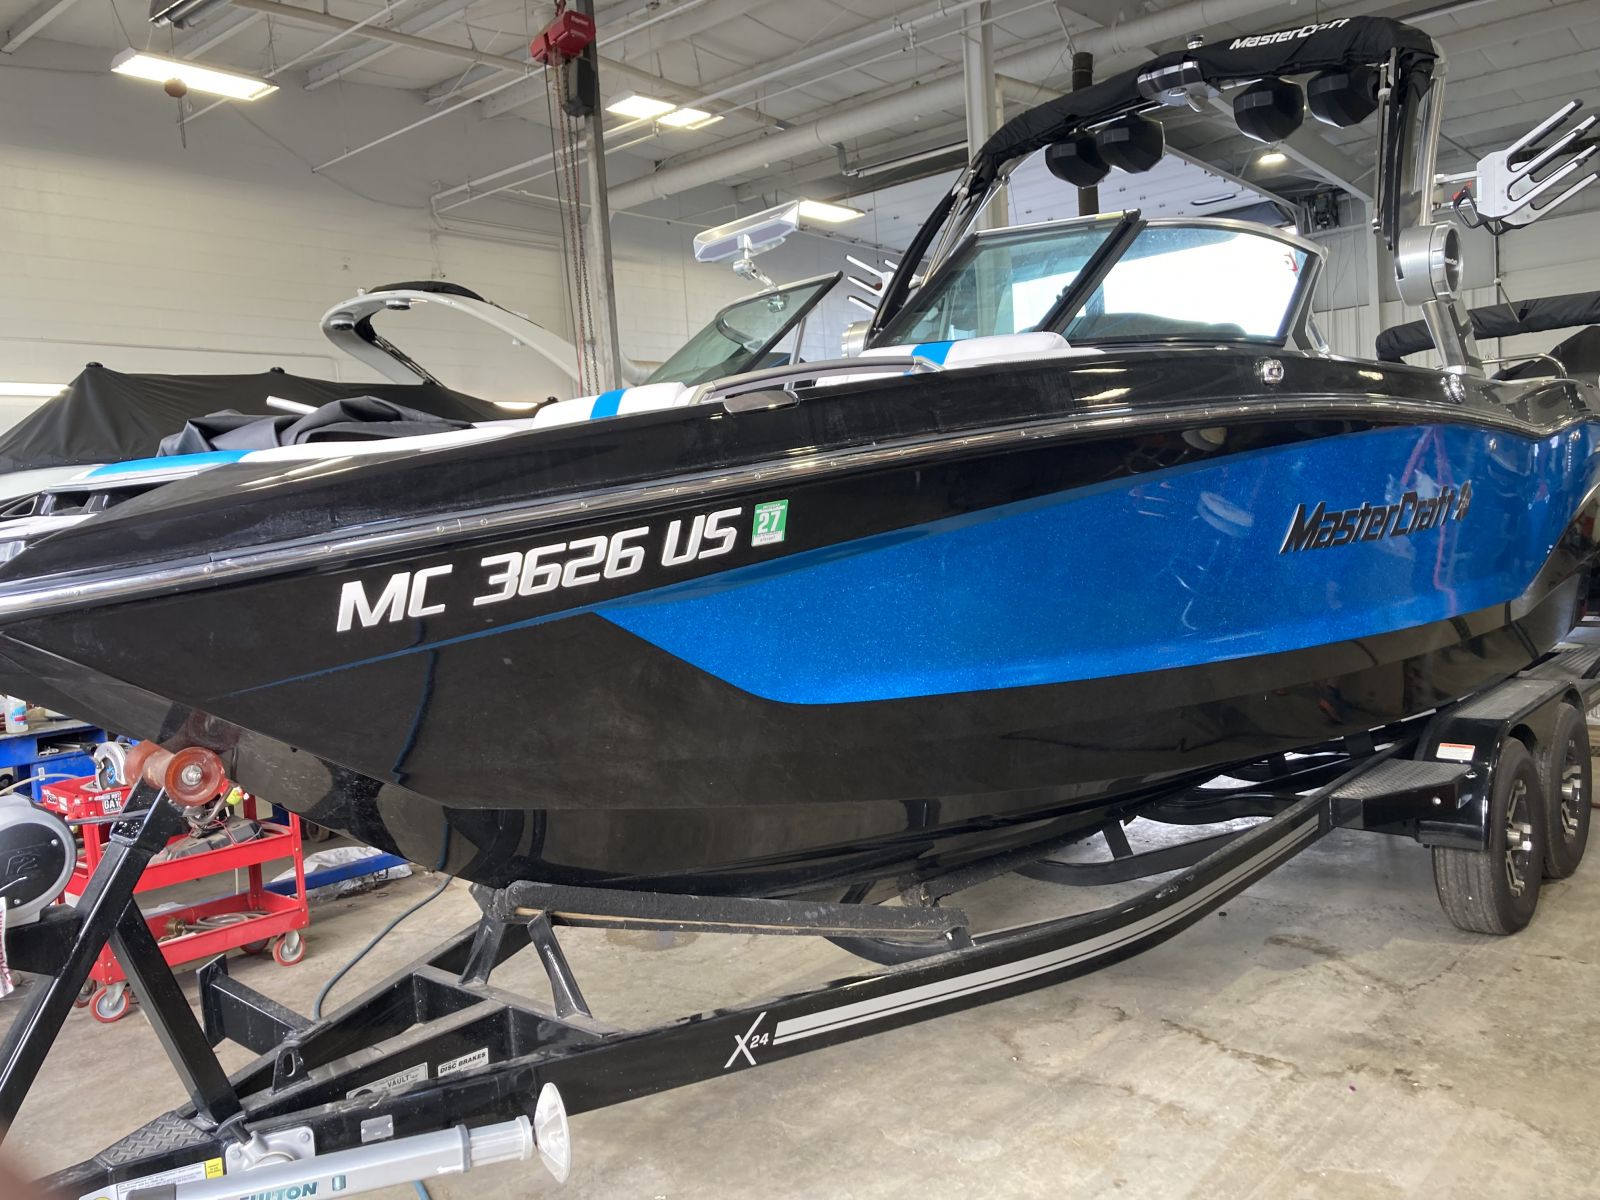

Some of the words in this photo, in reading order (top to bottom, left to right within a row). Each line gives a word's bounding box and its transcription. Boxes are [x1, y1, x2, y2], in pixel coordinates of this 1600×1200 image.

[757, 510, 781, 534] 27
[1278, 485, 1455, 555] MasterCraft
[336, 563, 454, 633] MC
[472, 525, 650, 607] 3626
[660, 506, 743, 567] US
[440, 1063, 457, 1074] DISC
[458, 1052, 486, 1067] BRAKES
[387, 1074, 410, 1088] VAULT
[240, 1181, 318, 1200] LTON
